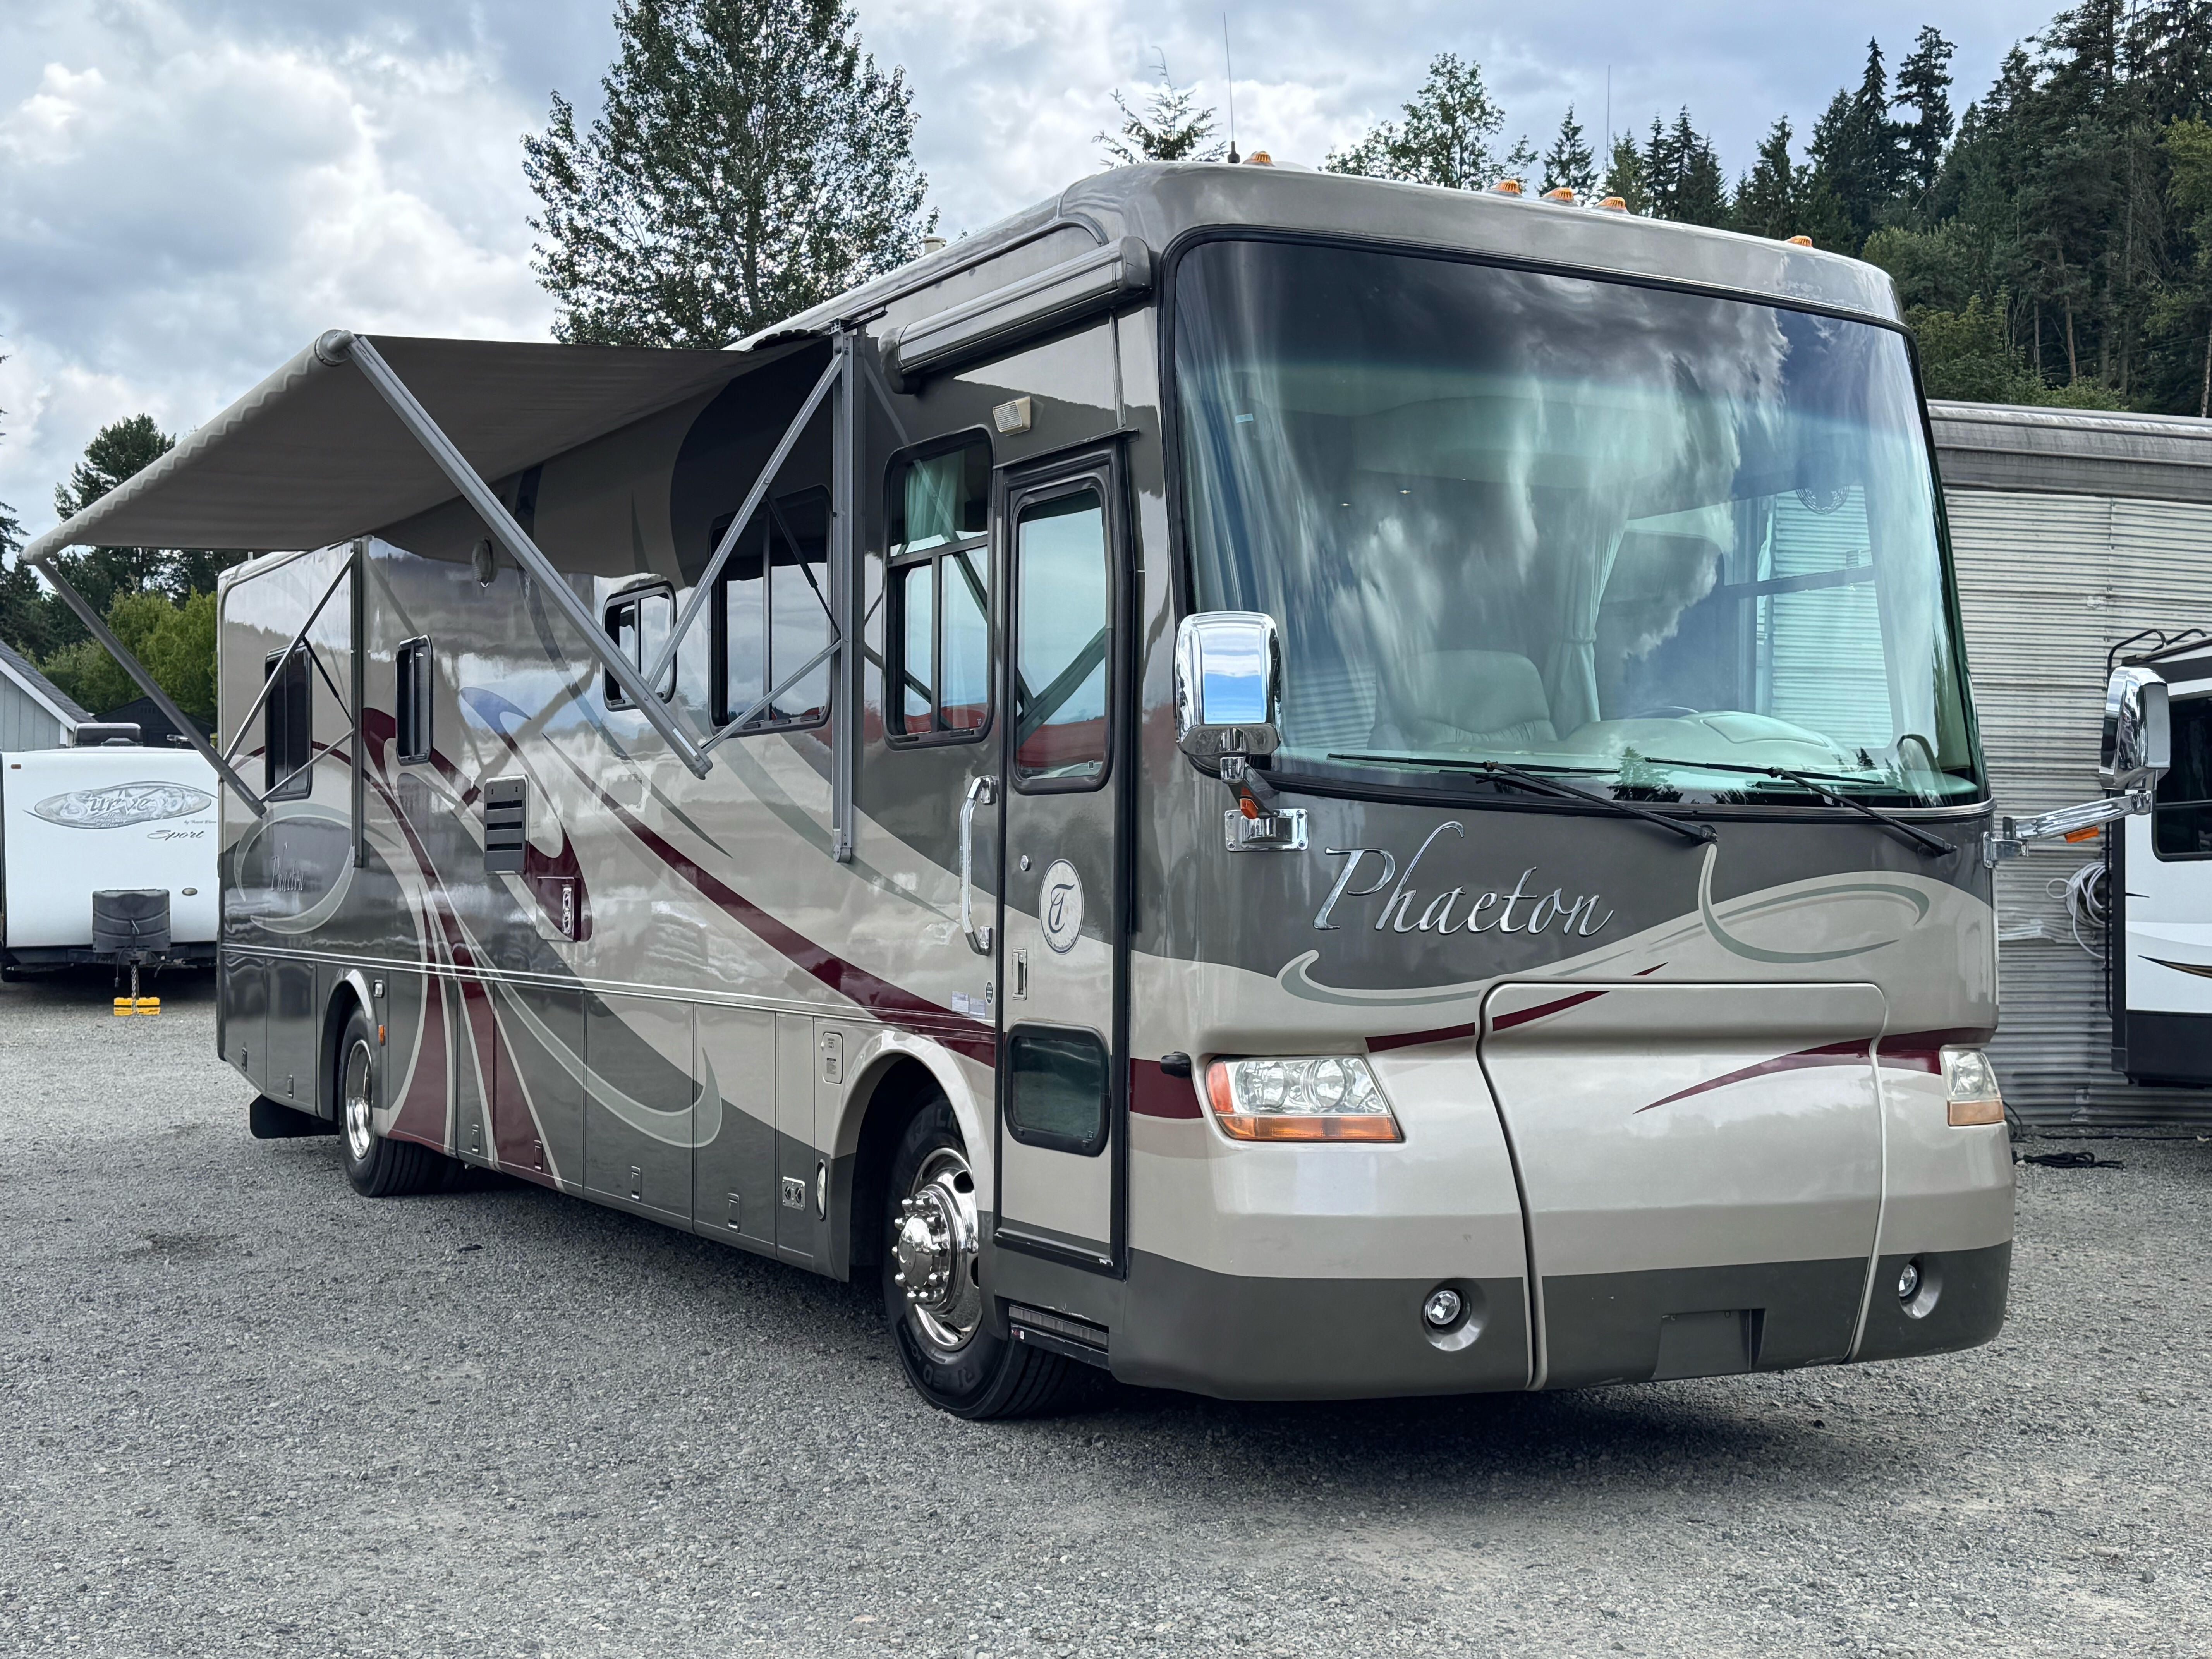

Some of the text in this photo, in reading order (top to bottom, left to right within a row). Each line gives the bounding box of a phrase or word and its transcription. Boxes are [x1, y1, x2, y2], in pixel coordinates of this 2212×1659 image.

[60, 789, 201, 821] Surveyor
[147, 830, 204, 841] Sport
[1312, 820, 1614, 937] Phaeton
